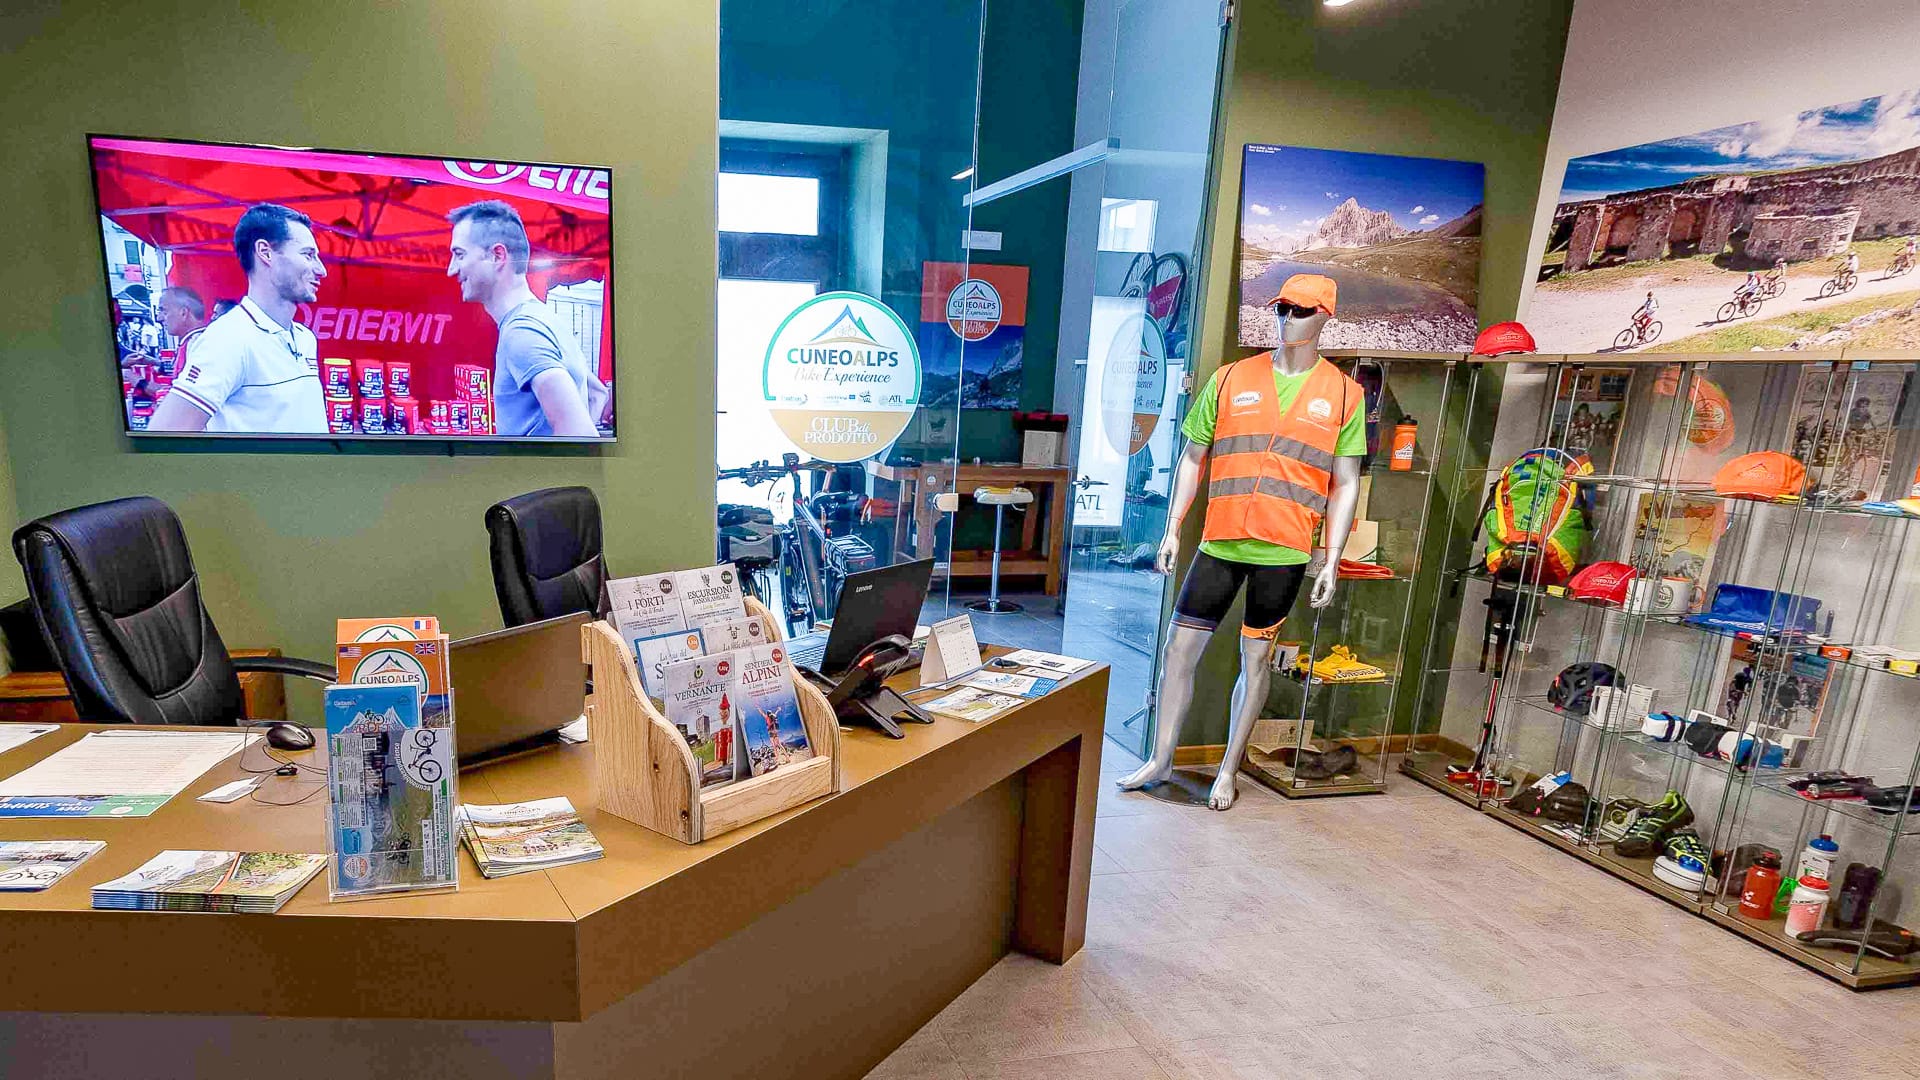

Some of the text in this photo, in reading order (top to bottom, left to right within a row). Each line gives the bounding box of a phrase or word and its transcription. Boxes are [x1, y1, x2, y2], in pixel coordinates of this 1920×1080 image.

[312, 307, 453, 344] ENERVIT
[787, 348, 899, 367] CUNEOALPS
[823, 367, 892, 386] Experience
[811, 417, 870, 433] CLUB di
[804, 432, 878, 444] PRODOTTO
[1076, 494, 1104, 510] ATL
[687, 585, 733, 600] ESCURSIONI
[634, 595, 665, 609] FORTI
[360, 674, 420, 685] CUNEOALPS
[742, 665, 781, 684] ALPINI
[675, 683, 726, 701] VERNANTE
